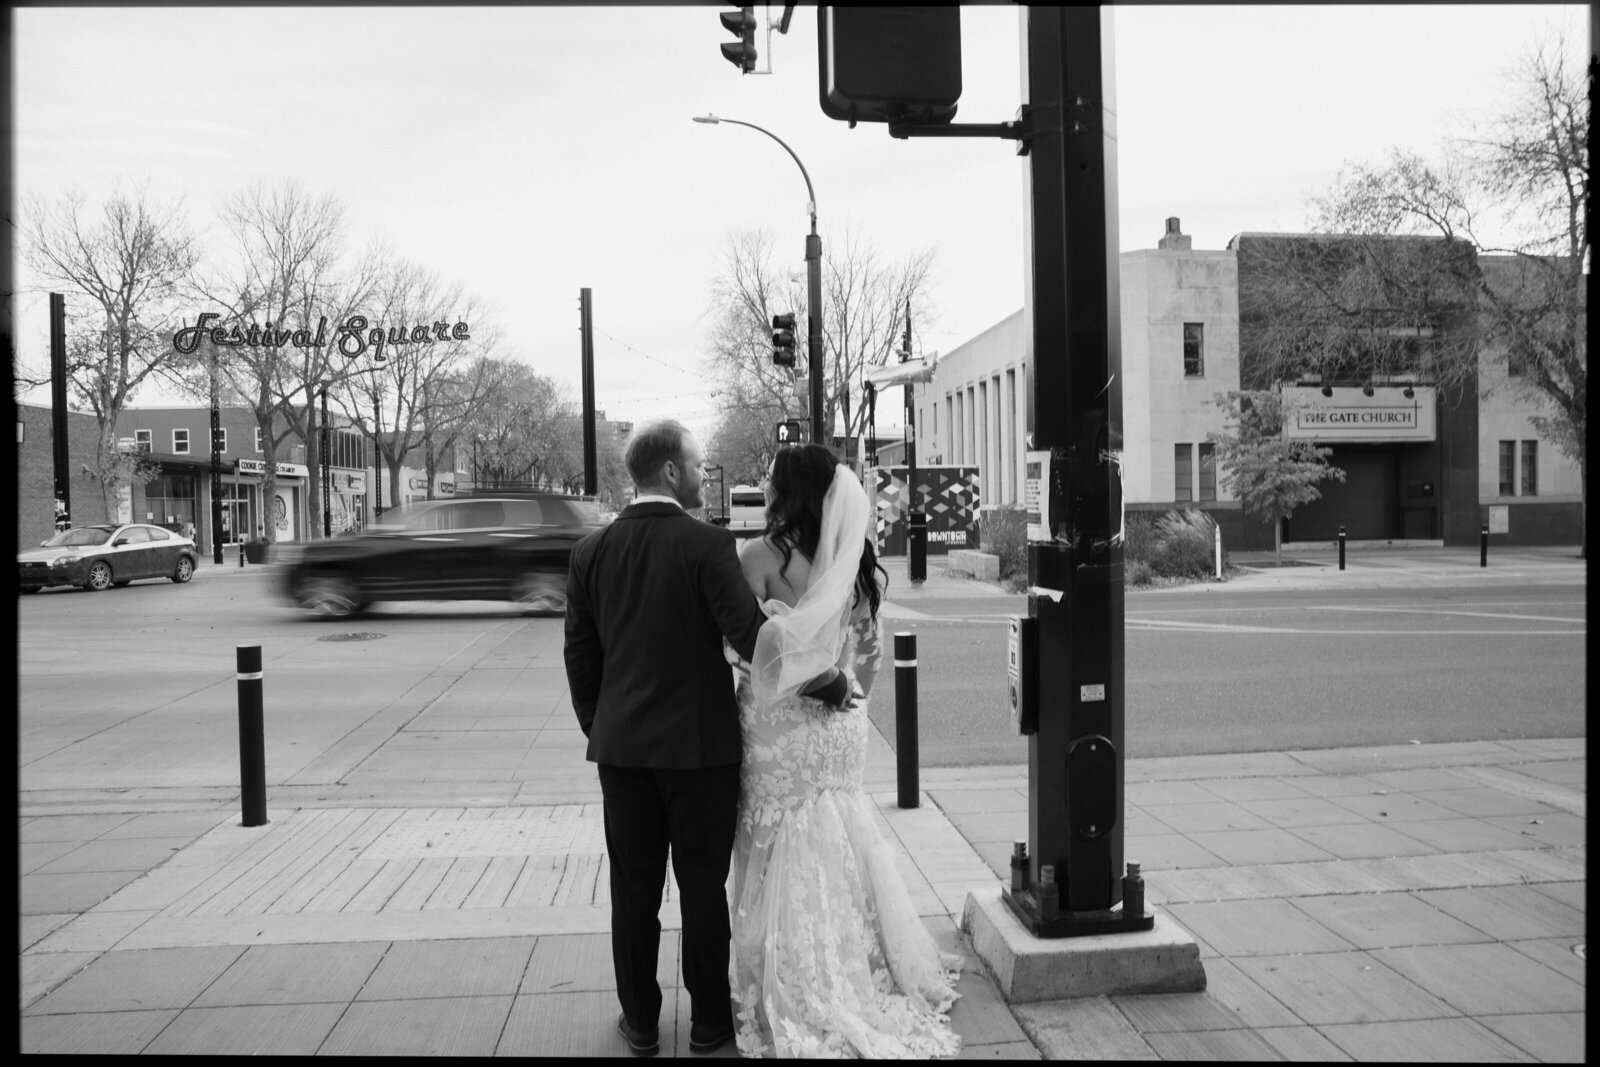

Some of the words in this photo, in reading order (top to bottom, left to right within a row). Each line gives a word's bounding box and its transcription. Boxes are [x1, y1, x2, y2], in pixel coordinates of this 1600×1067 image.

[173, 312, 326, 354] Festival
[338, 315, 470, 361] Square
[1304, 412, 1327, 423] THE
[1329, 412, 1360, 423] GATE
[1361, 412, 1411, 423] CHURCH
[928, 531, 966, 541] DOWNTOWN
